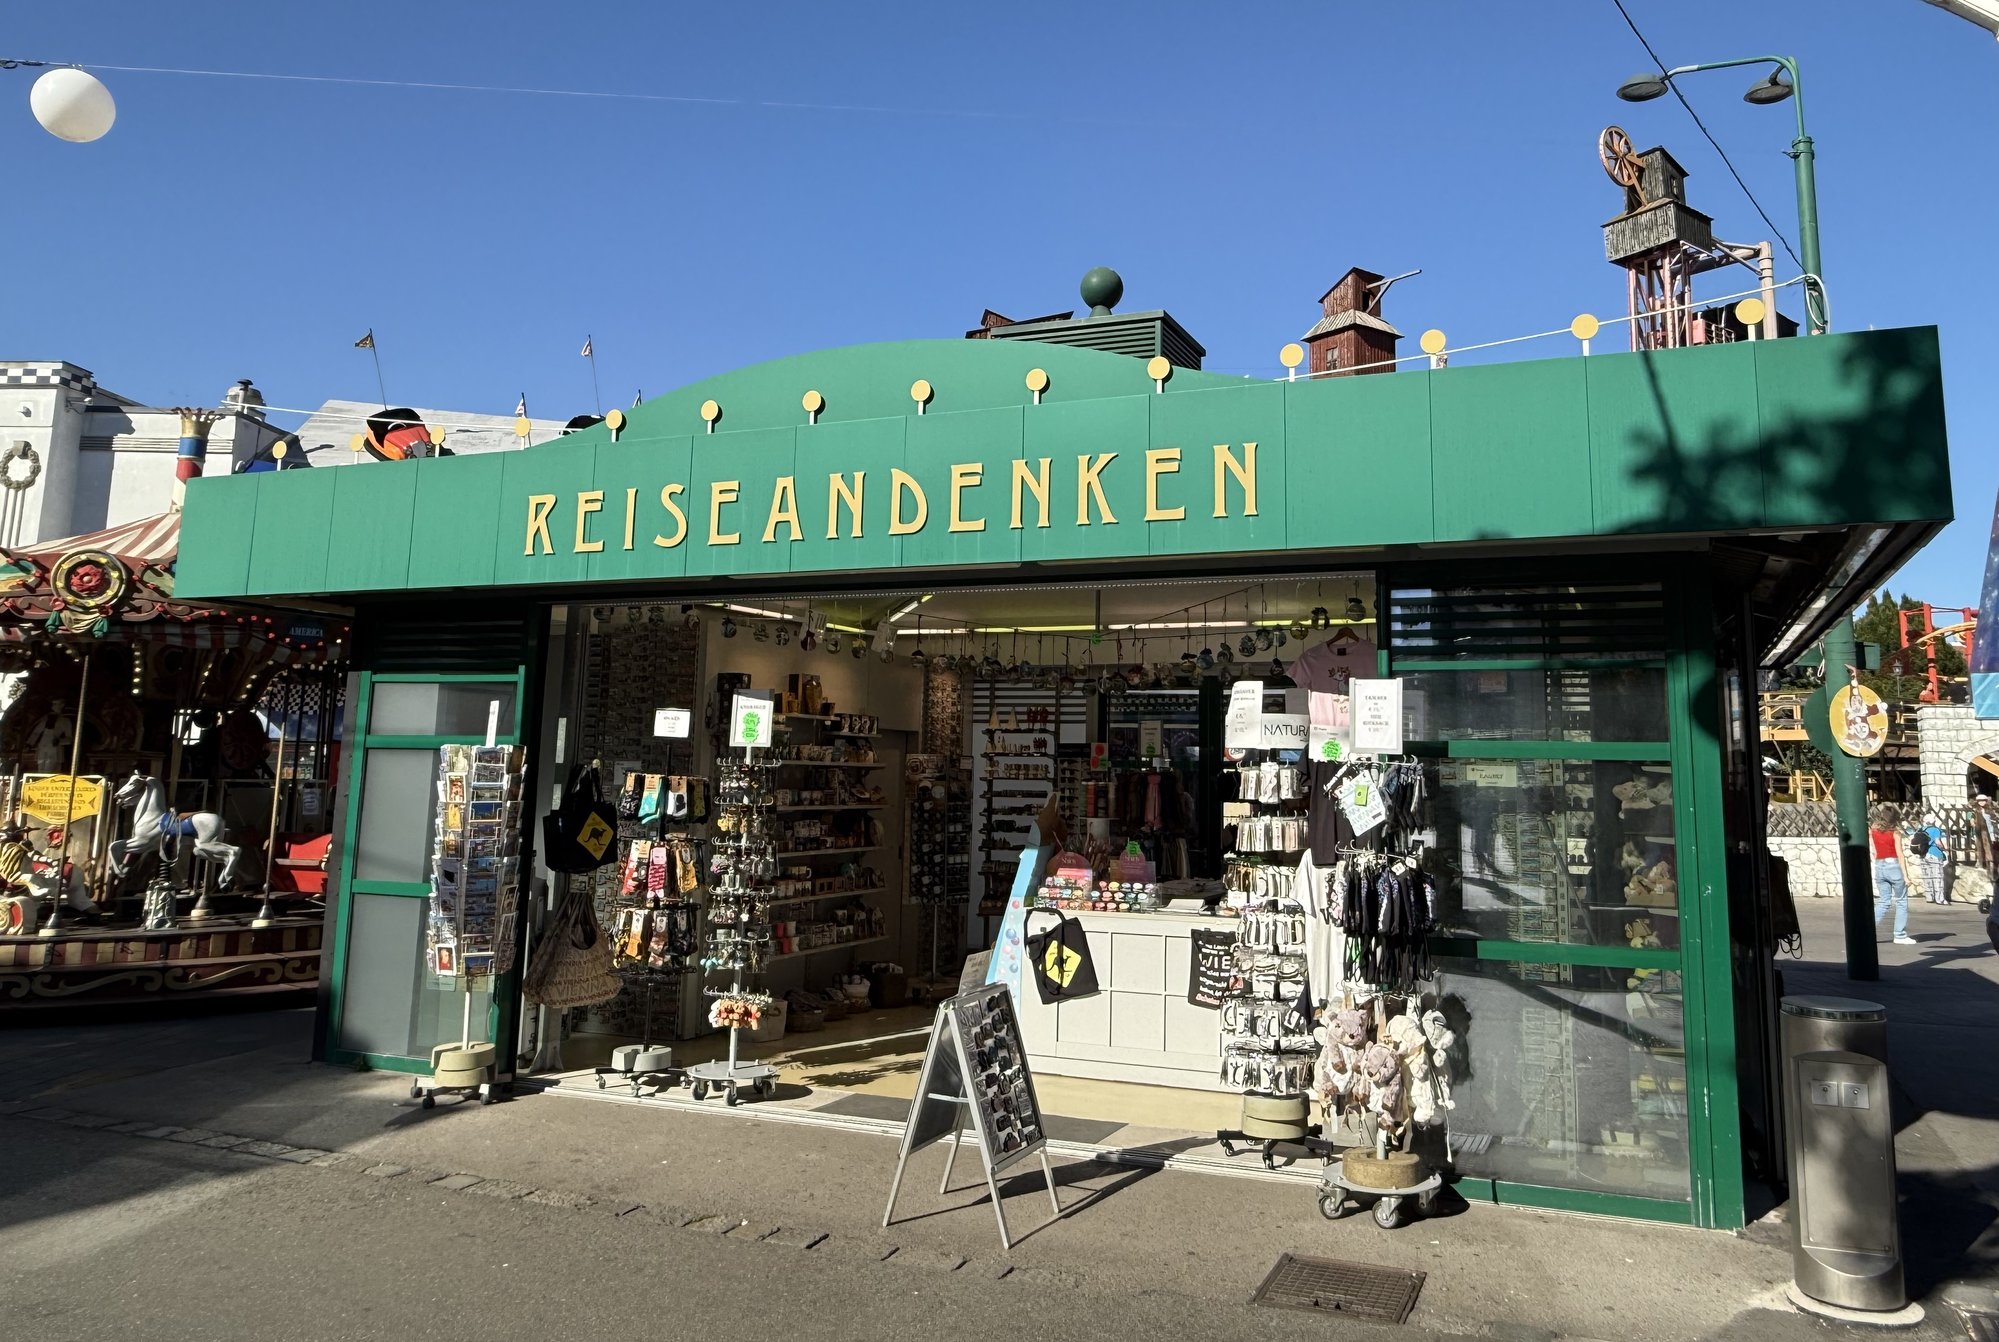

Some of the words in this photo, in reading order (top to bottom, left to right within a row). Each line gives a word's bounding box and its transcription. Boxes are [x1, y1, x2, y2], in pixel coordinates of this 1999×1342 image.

[524, 442, 1259, 556] REISEANDENKEN
[288, 627, 323, 637] AMERICA
[1198, 954, 1231, 969] WIE
